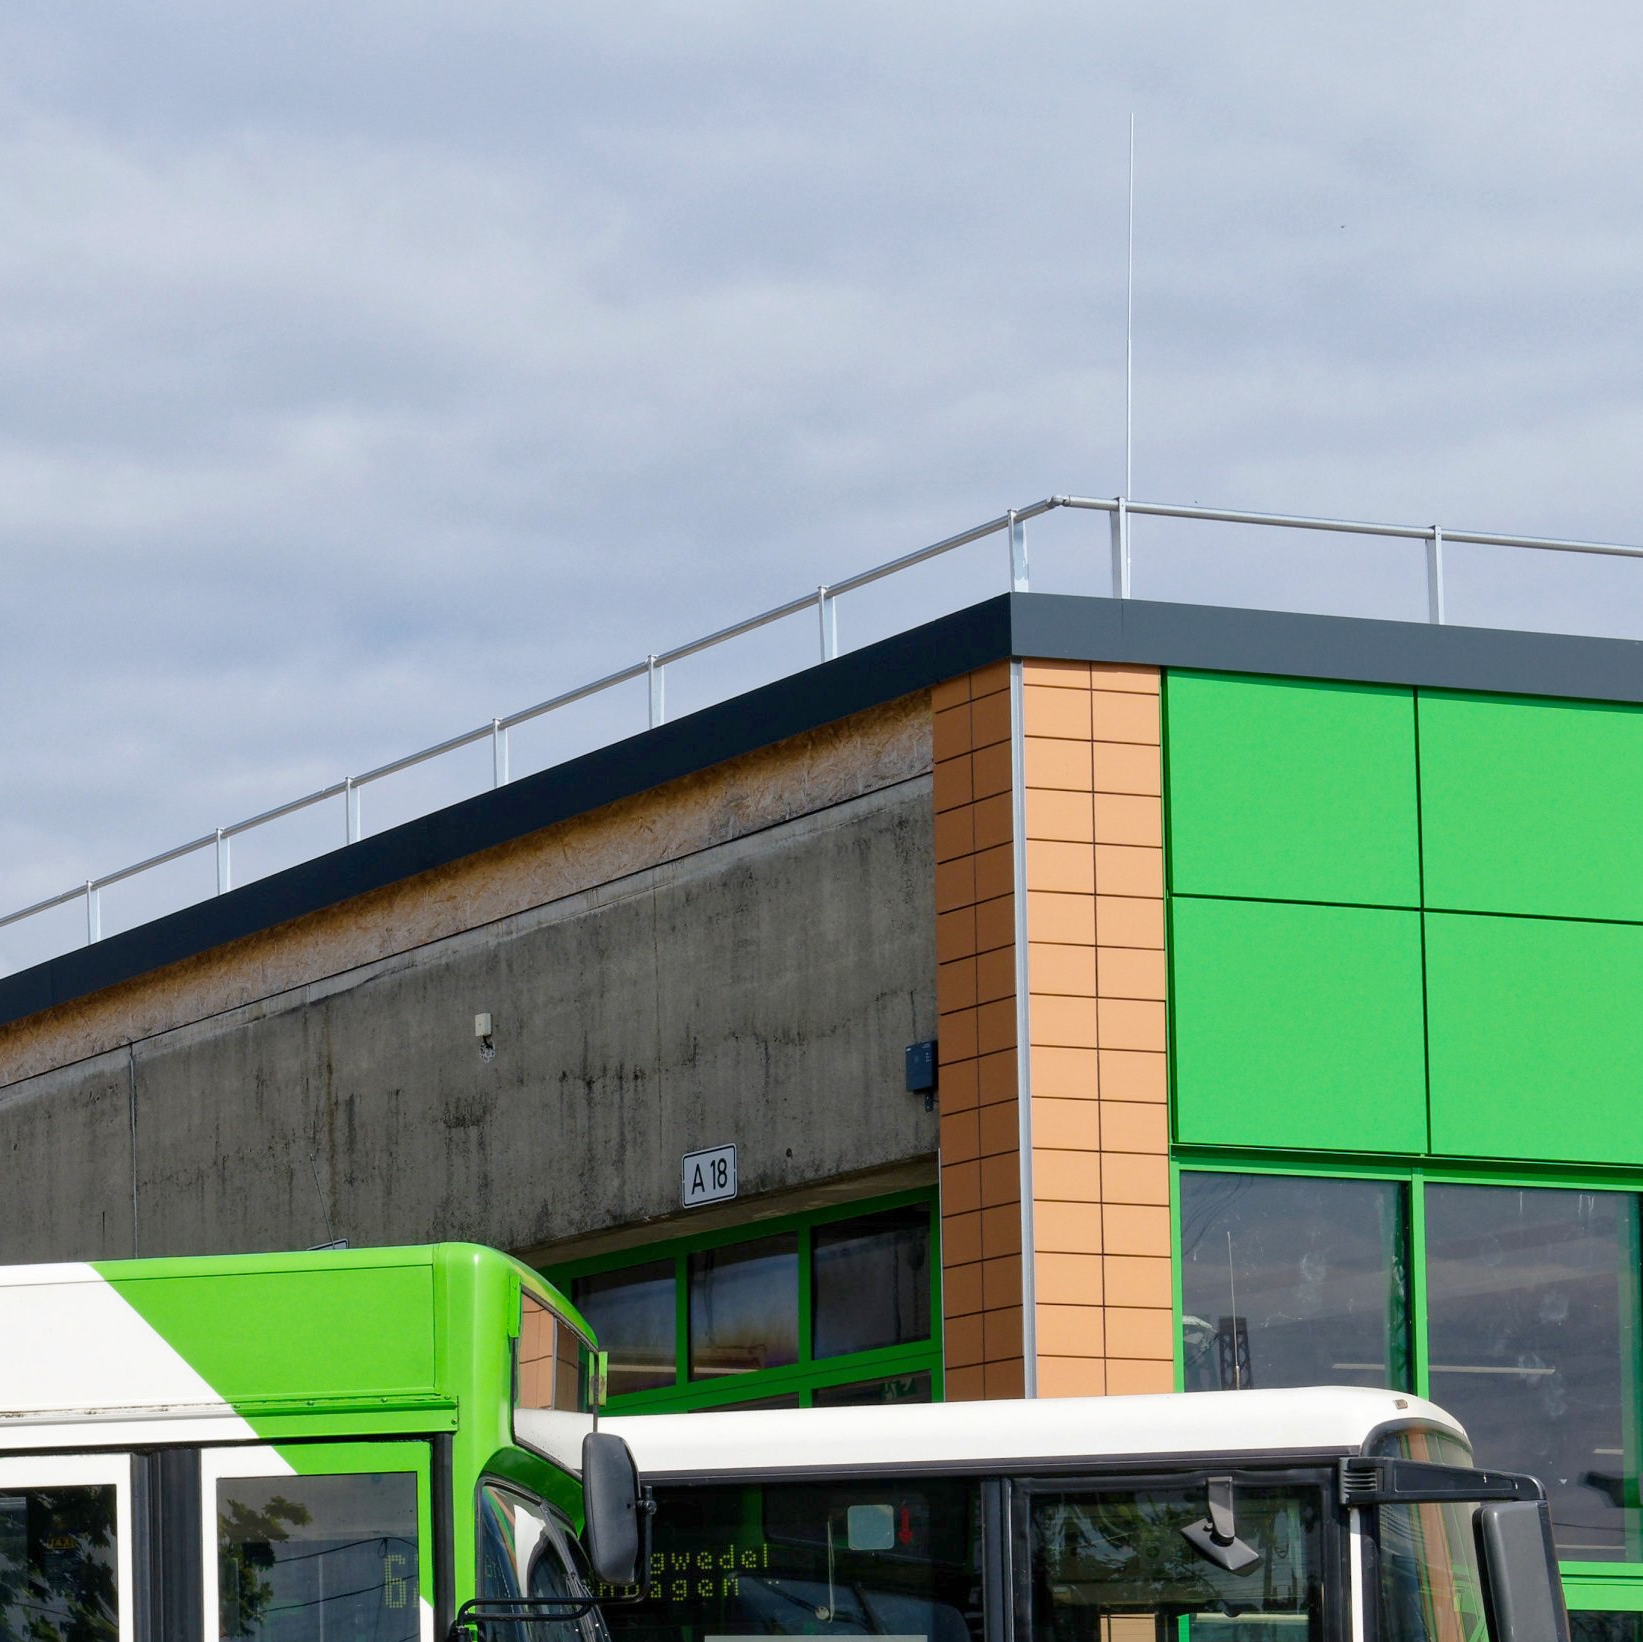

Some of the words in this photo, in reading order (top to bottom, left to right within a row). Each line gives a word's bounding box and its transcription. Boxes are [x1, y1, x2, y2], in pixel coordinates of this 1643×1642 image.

[691, 1163, 705, 1195] A
[710, 1158, 727, 1190] 18
[650, 1543, 768, 1575] gwedel
